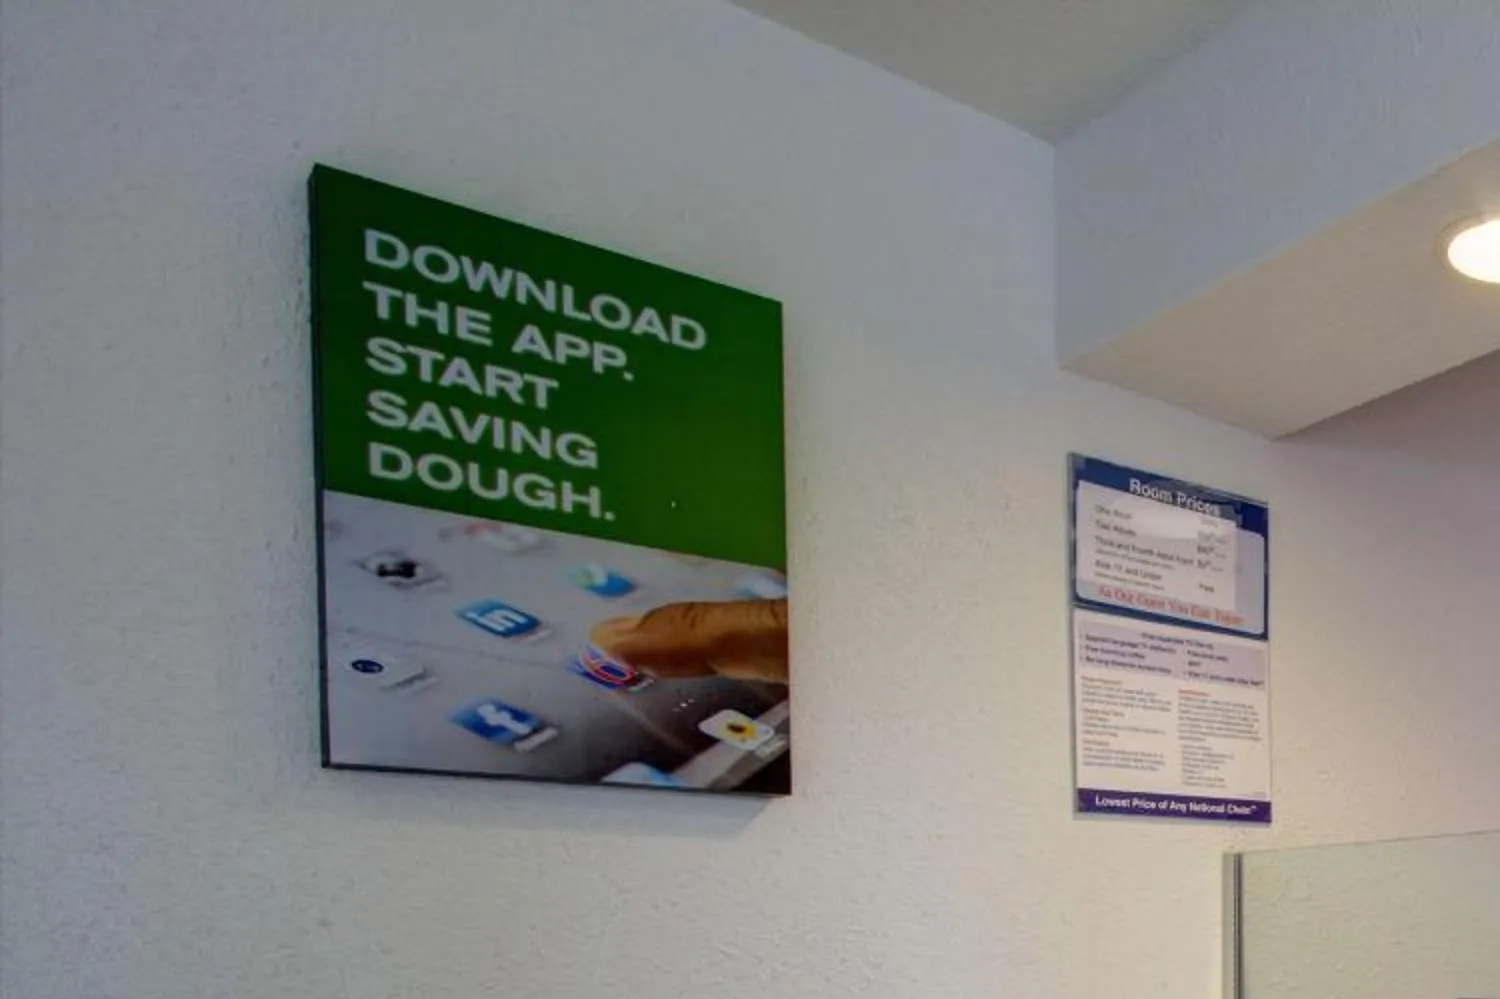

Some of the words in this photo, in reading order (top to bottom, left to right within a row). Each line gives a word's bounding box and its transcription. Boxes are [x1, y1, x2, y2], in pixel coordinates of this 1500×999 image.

[363, 228, 708, 351] DOWNLOAD
[363, 280, 493, 346] THE
[512, 325, 634, 381] APP.
[366, 337, 558, 409] START
[366, 390, 598, 469] SAVING
[369, 442, 615, 521] DOUGH.
[1129, 478, 1174, 507] Room
[1177, 491, 1220, 517] Prices
[1096, 795, 1131, 808] Lowest
[1132, 797, 1157, 810] Price
[1159, 798, 1168, 809] of
[1169, 799, 1187, 813] Any
[1189, 801, 1227, 814] National
